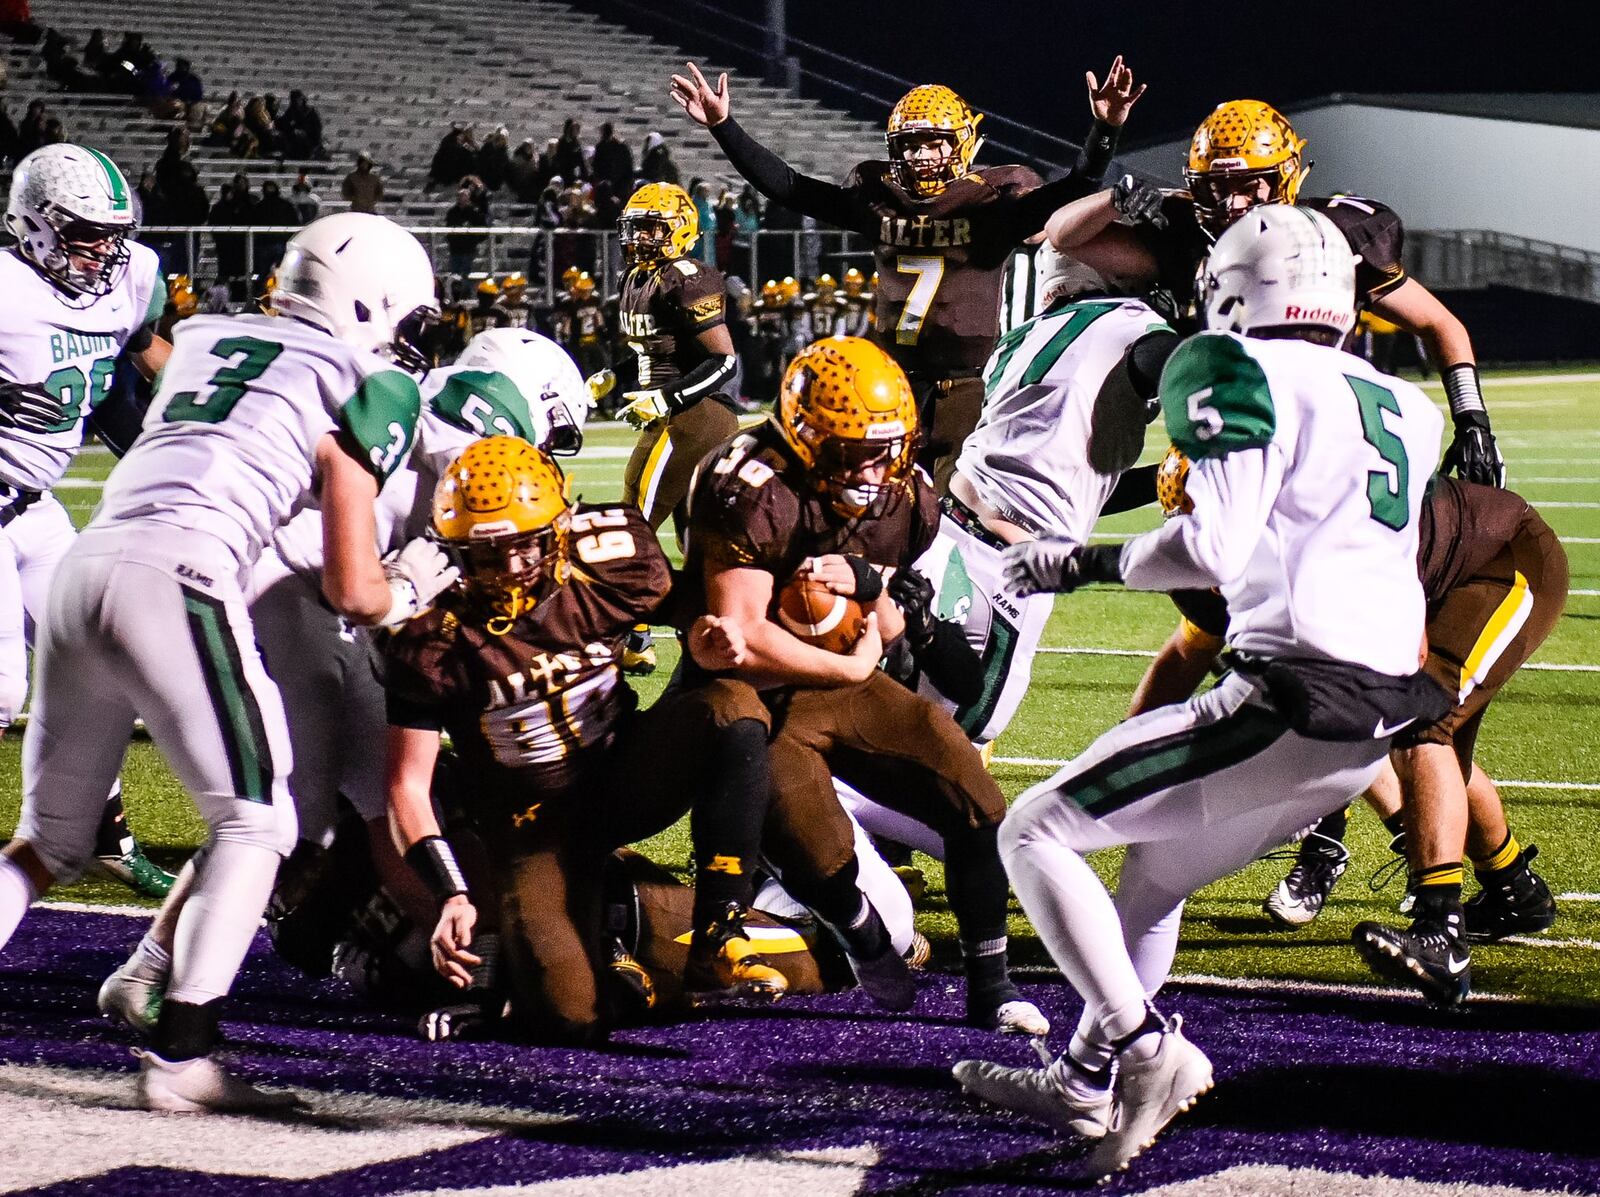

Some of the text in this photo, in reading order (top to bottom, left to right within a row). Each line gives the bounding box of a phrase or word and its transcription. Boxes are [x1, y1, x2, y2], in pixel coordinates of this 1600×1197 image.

[675, 194, 695, 214] A
[880, 215, 971, 247] ALTER
[896, 255, 945, 345] 7
[1285, 306, 1349, 325] Riddell
[162, 335, 284, 424] 3
[1187, 387, 1224, 441] 5
[370, 421, 406, 474] 3
[1342, 372, 1409, 532] 5
[992, 593, 1020, 619] RAMS
